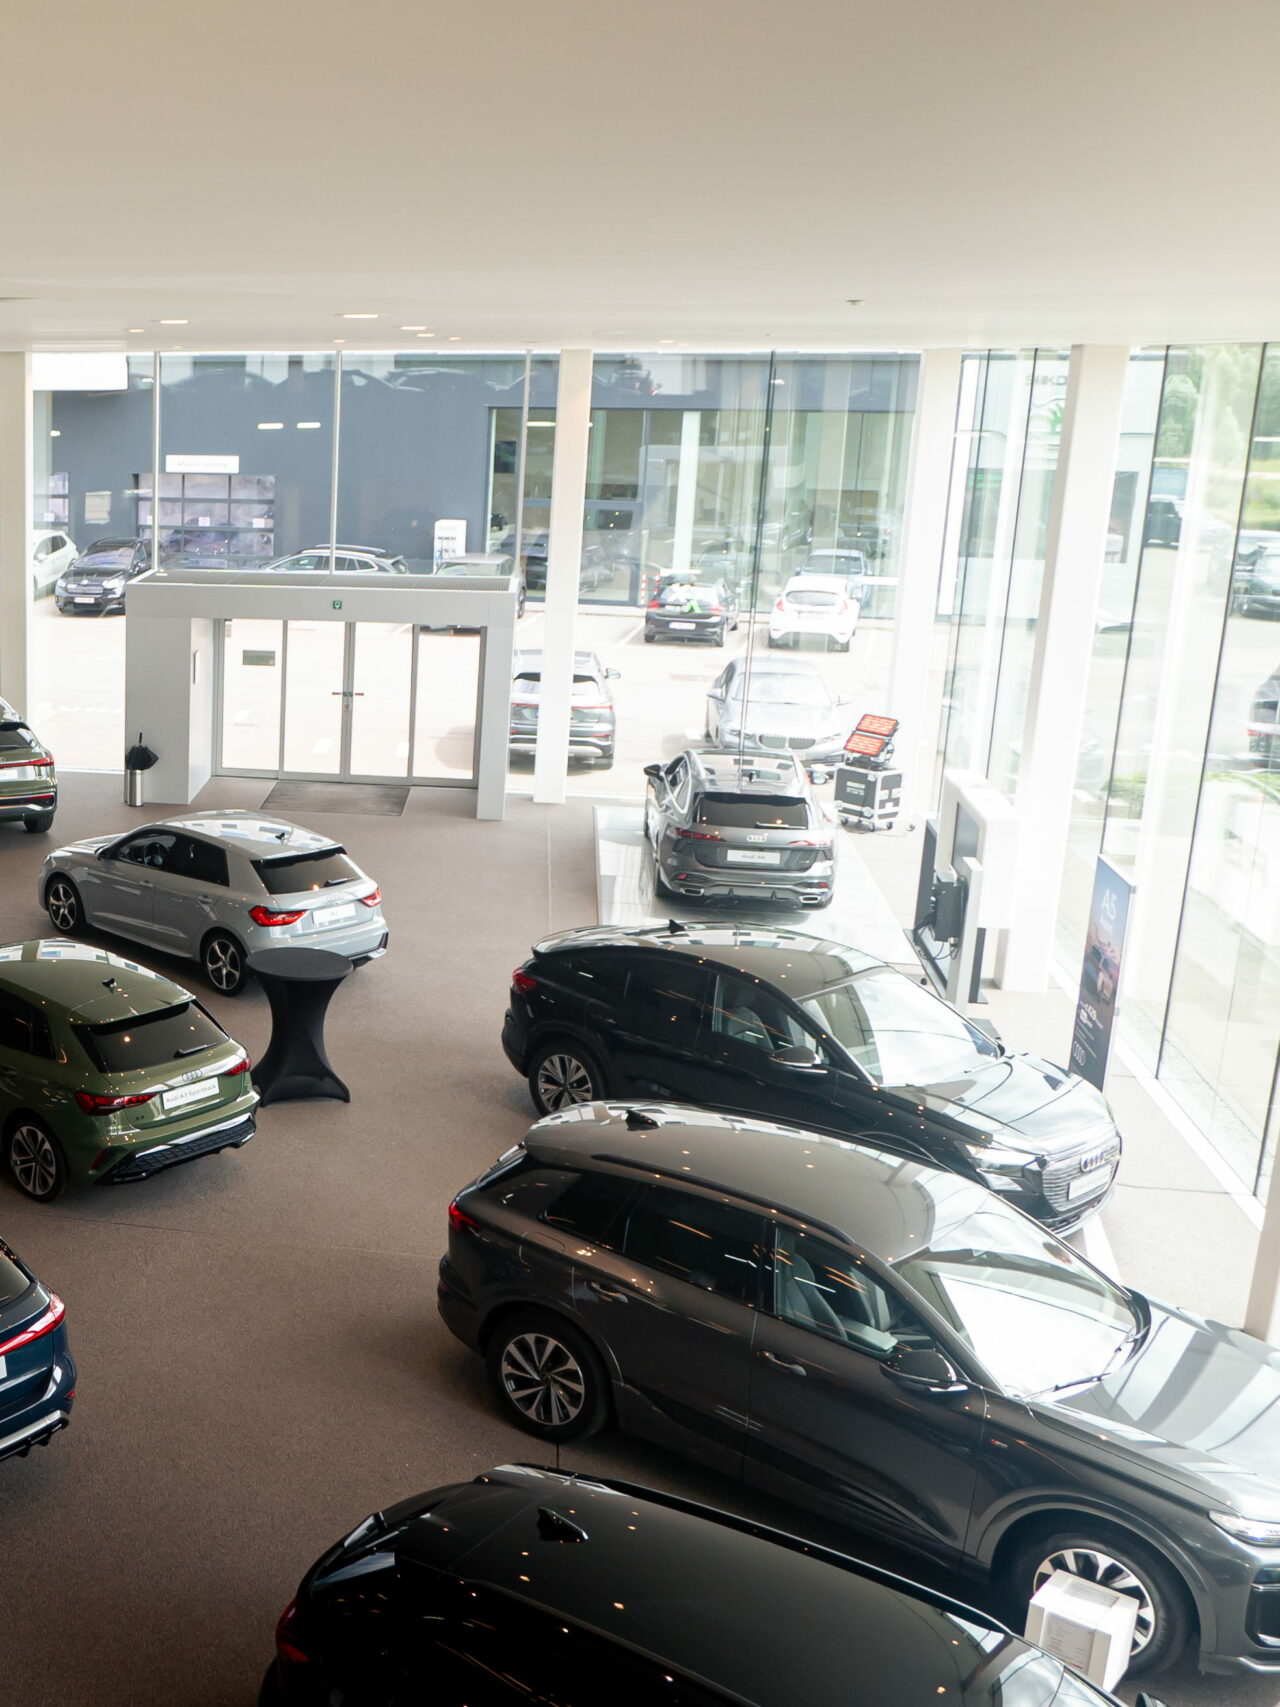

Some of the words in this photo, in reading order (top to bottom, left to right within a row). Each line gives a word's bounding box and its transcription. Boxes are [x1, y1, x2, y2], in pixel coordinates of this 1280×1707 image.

[1101, 889, 1118, 920] A5
[166, 1094, 180, 1103] Audi
[180, 1091, 189, 1099] A3
[189, 1084, 217, 1097] Sportback
